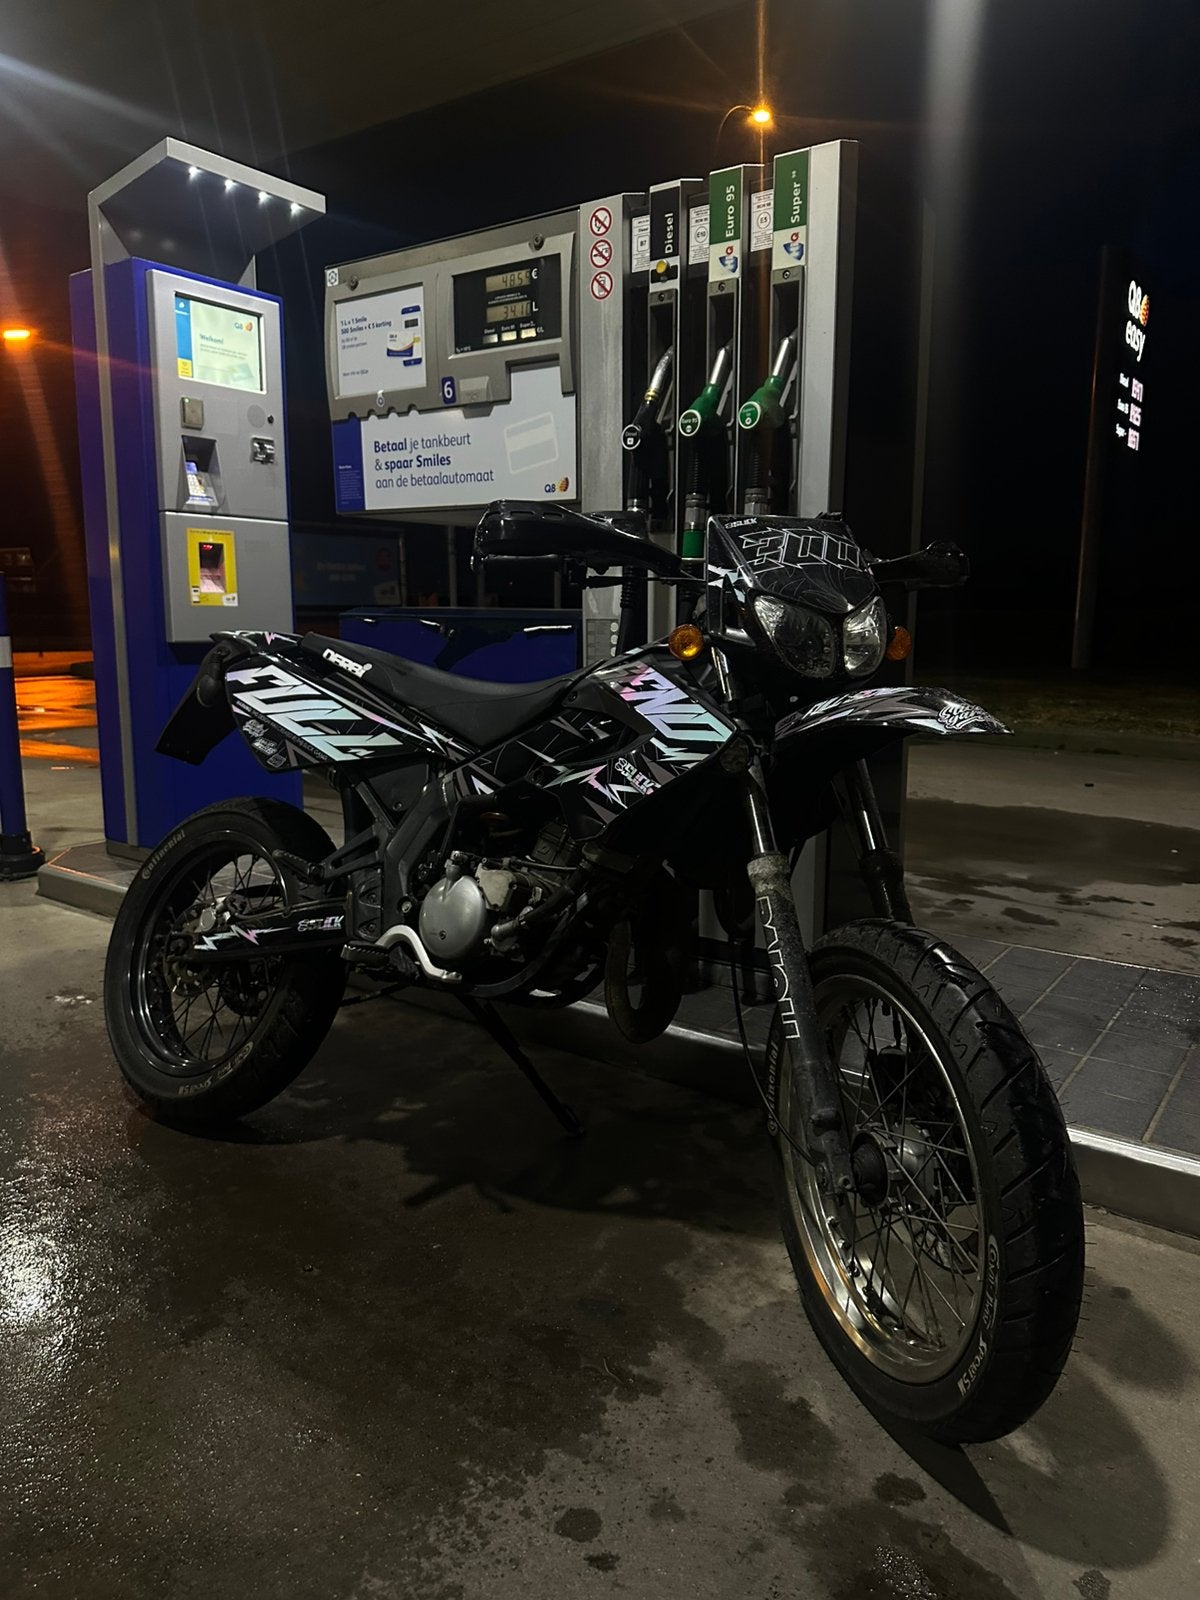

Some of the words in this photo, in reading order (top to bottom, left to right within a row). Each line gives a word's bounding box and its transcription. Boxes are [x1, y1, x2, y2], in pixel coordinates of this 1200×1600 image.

[725, 185, 735, 202] 95
[790, 182, 803, 223] Super
[725, 205, 735, 238] Euro
[664, 213, 674, 254] Diesel
[532, 301, 539, 312] L
[1128, 280, 1142, 319] Q8
[1125, 320, 1146, 362] easy
[444, 381, 453, 399] 6
[374, 438, 407, 453] Betaal
[409, 438, 419, 454] je
[421, 433, 471, 449] tankbeurt
[374, 458, 383, 471] &
[385, 459, 414, 473] spaar
[416, 453, 452, 468] Smiles
[376, 478, 395, 489] aan
[396, 475, 409, 488] de
[410, 470, 495, 487] betaalautomaat
[544, 484, 556, 493] Q8
